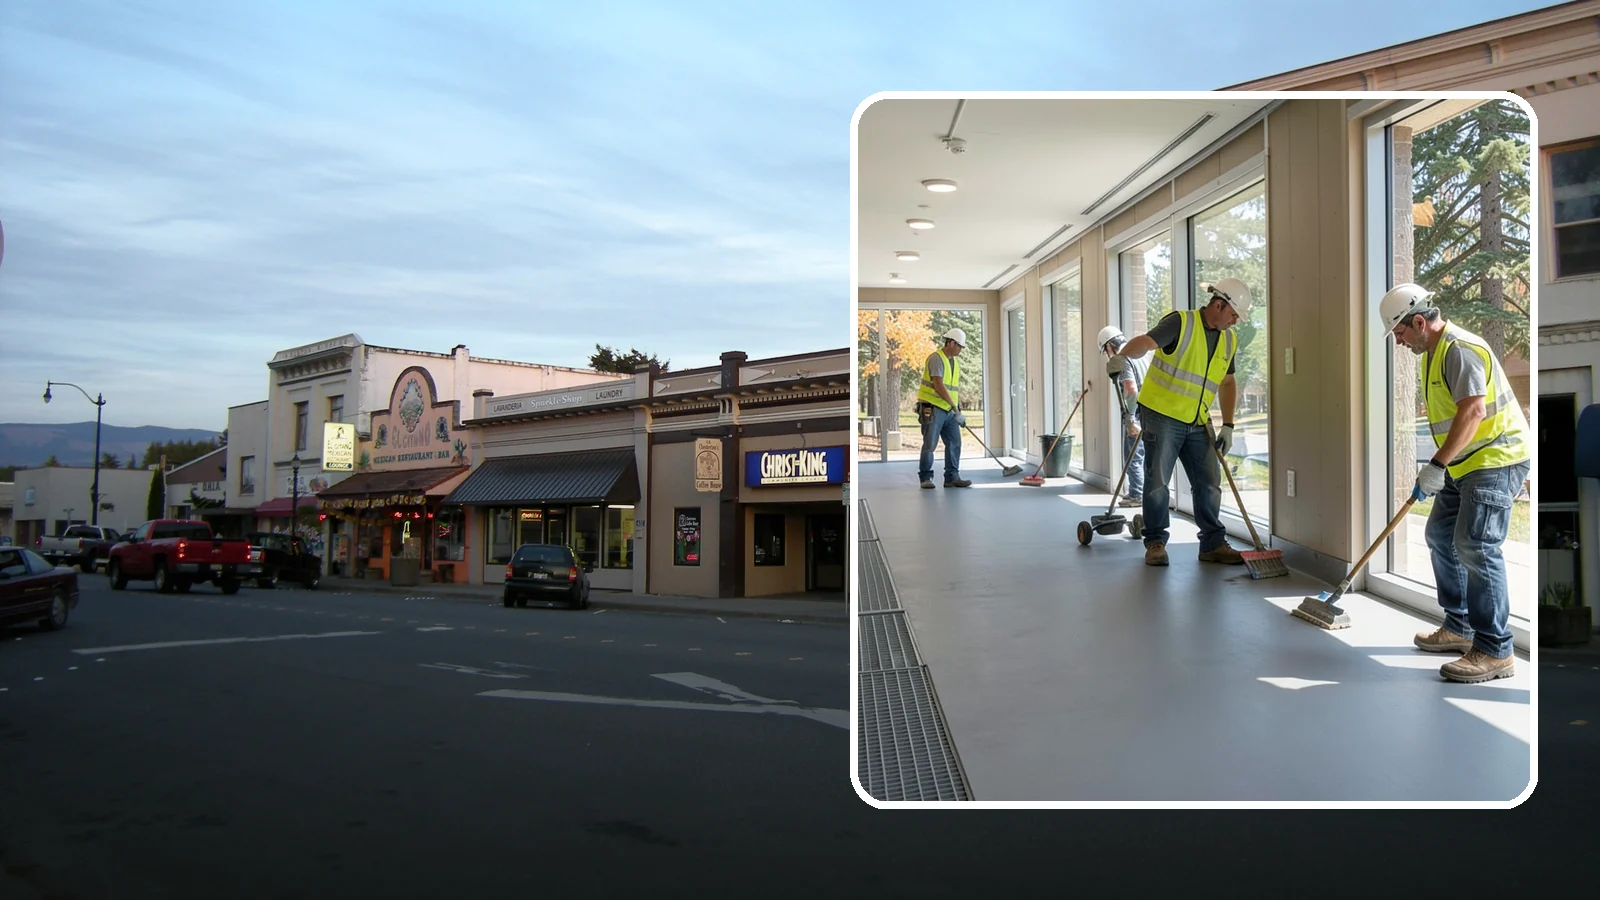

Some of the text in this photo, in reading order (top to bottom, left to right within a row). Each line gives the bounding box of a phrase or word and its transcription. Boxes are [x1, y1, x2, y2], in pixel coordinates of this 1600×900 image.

[561, 394, 583, 405] Shop
[595, 389, 623, 400] LAUNDRY
[493, 402, 523, 413] LAVANDERIA
[373, 454, 396, 464] MEXICAN
[397, 451, 433, 462] RESTAURANT
[438, 450, 450, 459] BAR
[799, 450, 827, 477] KING
